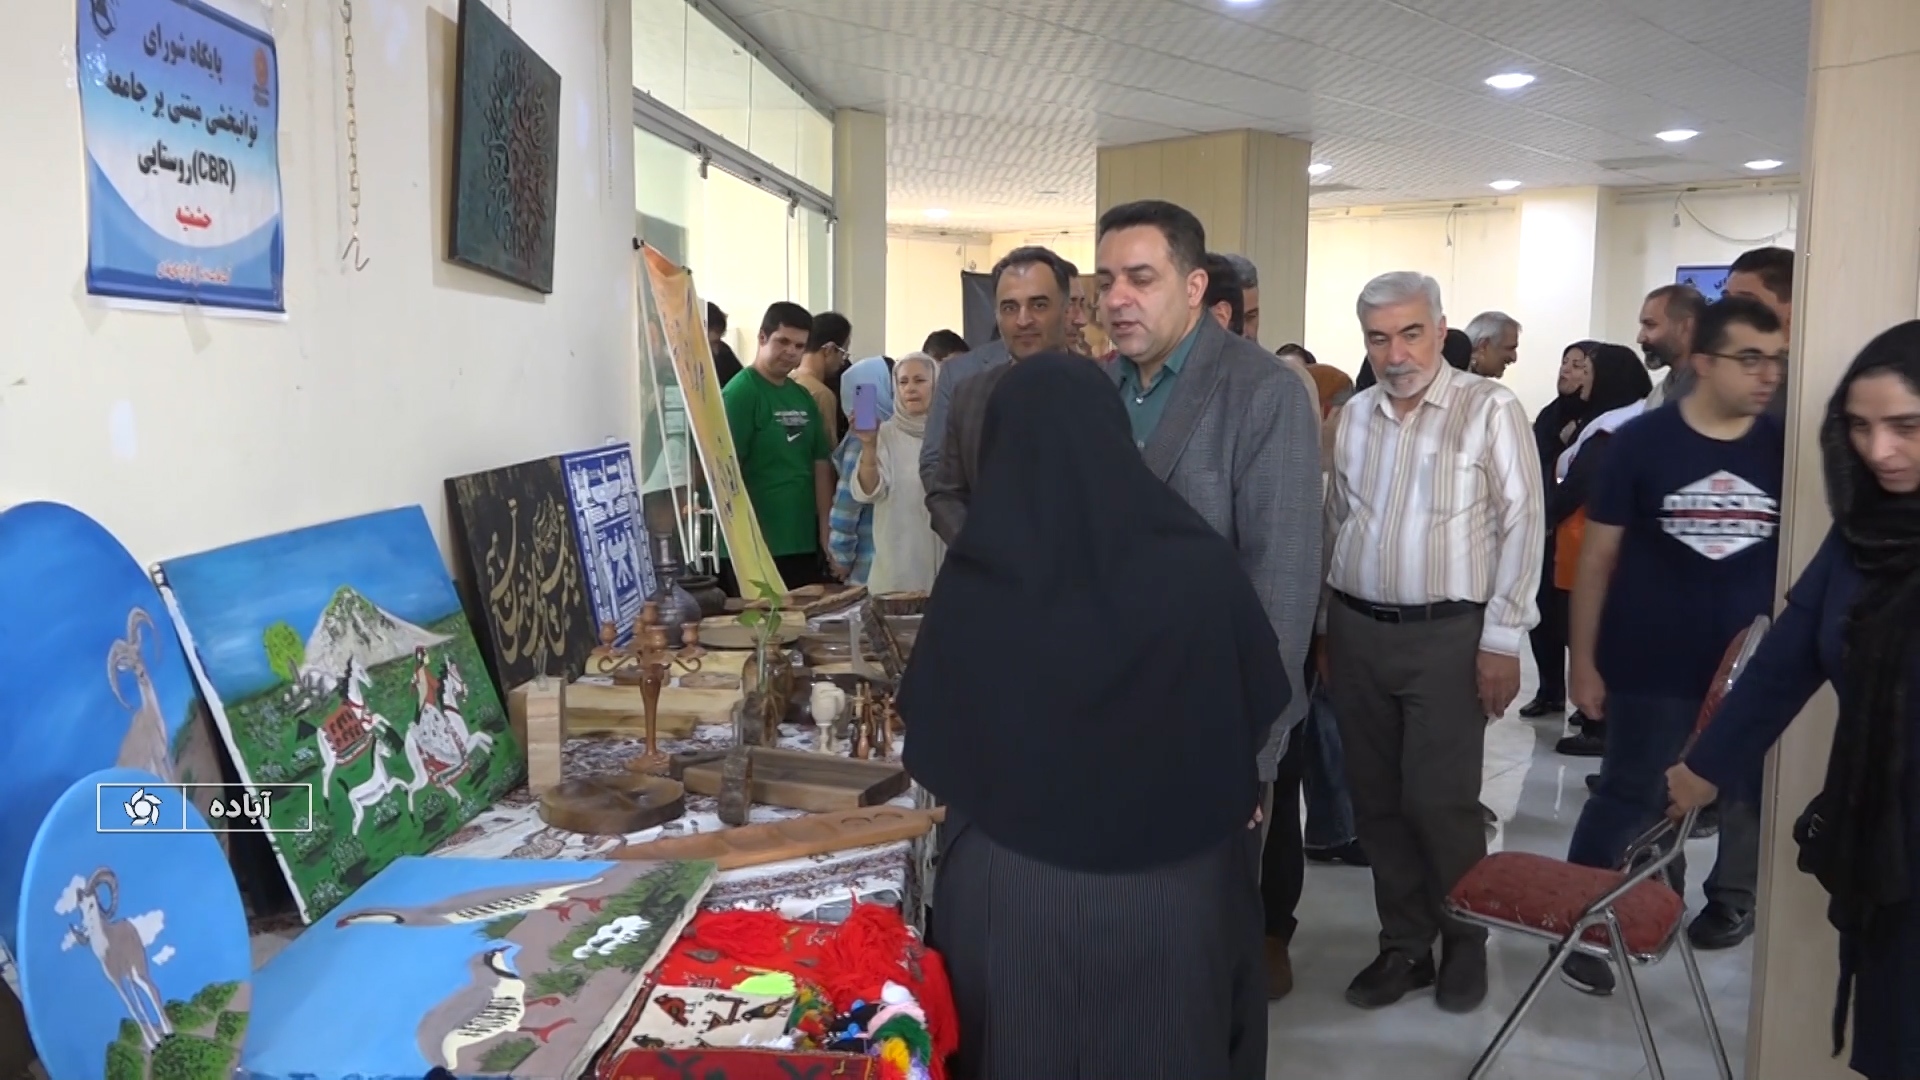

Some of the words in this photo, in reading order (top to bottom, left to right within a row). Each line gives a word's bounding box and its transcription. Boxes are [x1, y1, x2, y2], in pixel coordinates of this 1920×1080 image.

[143, 22, 187, 66] شورای
[189, 38, 224, 85] پایگاه
[105, 69, 148, 112] جامعه
[152, 90, 165, 118] بر
[167, 93, 203, 128] مبتنی
[205, 104, 259, 148] توانبخشی
